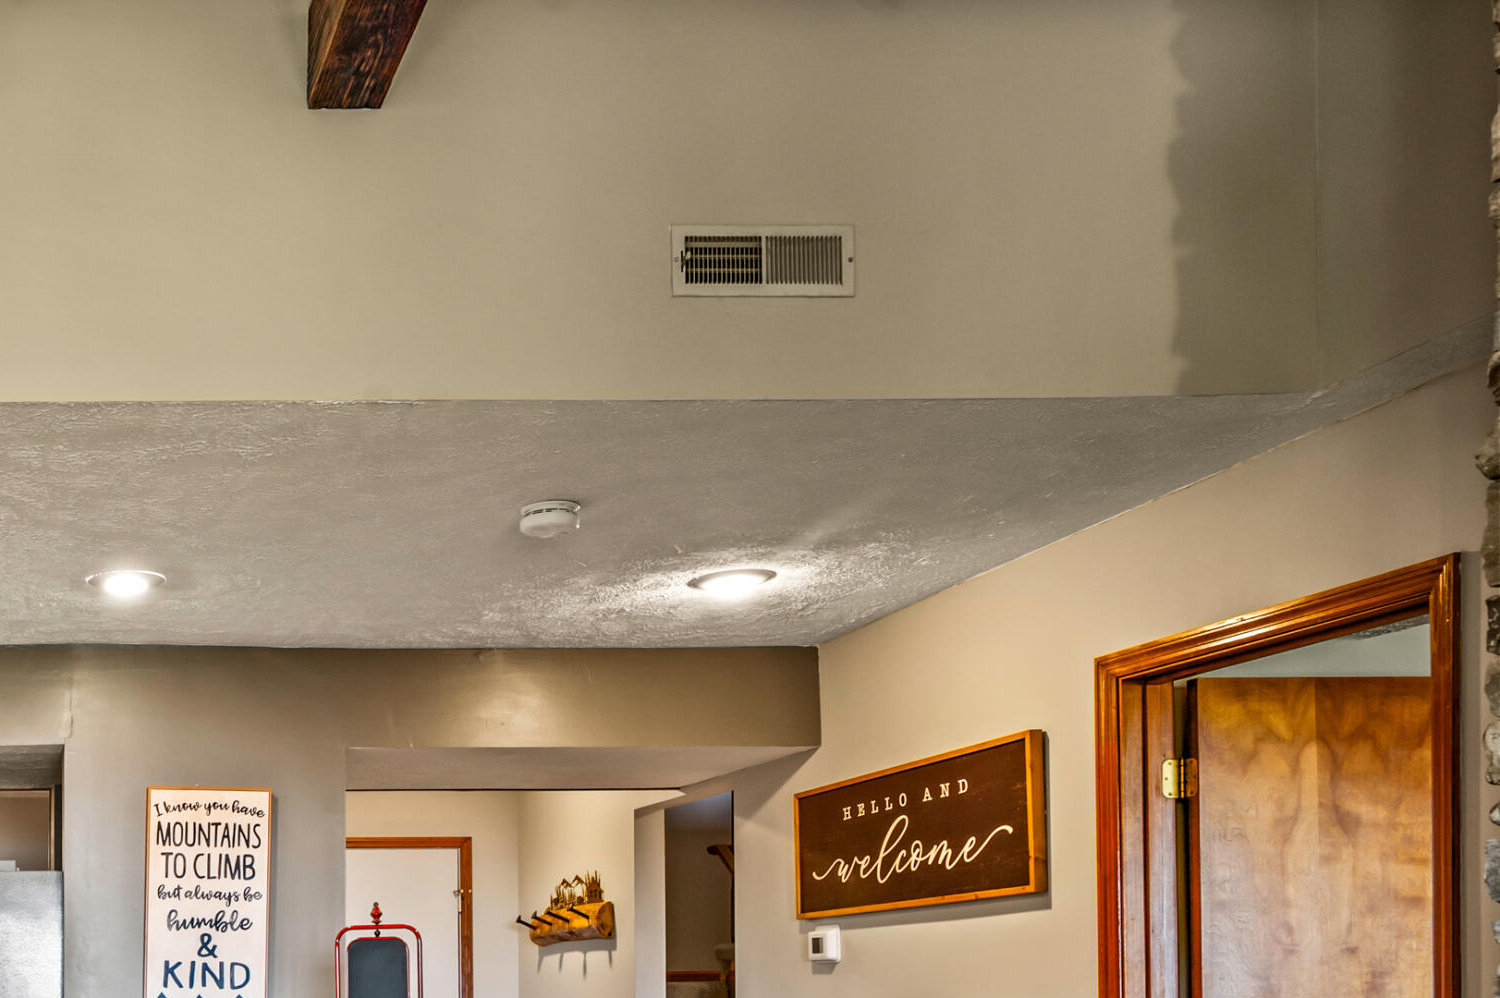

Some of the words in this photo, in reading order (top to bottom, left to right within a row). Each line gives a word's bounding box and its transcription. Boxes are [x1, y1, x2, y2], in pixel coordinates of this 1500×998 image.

[153, 803, 163, 817] I
[163, 801, 201, 814] know
[203, 801, 229, 816] you
[231, 800, 265, 818] have
[842, 793, 908, 821] HELLO
[922, 778, 969, 802] AND
[156, 820, 261, 849] MOUNTAINS
[812, 815, 1014, 884] welcome
[160, 852, 187, 879] TO
[193, 852, 256, 880] CLIMB
[157, 884, 183, 901] but
[184, 884, 241, 907] always
[243, 886, 263, 902] be
[166, 909, 253, 933] humble
[197, 933, 218, 958] &
[163, 960, 250, 990] KIND
